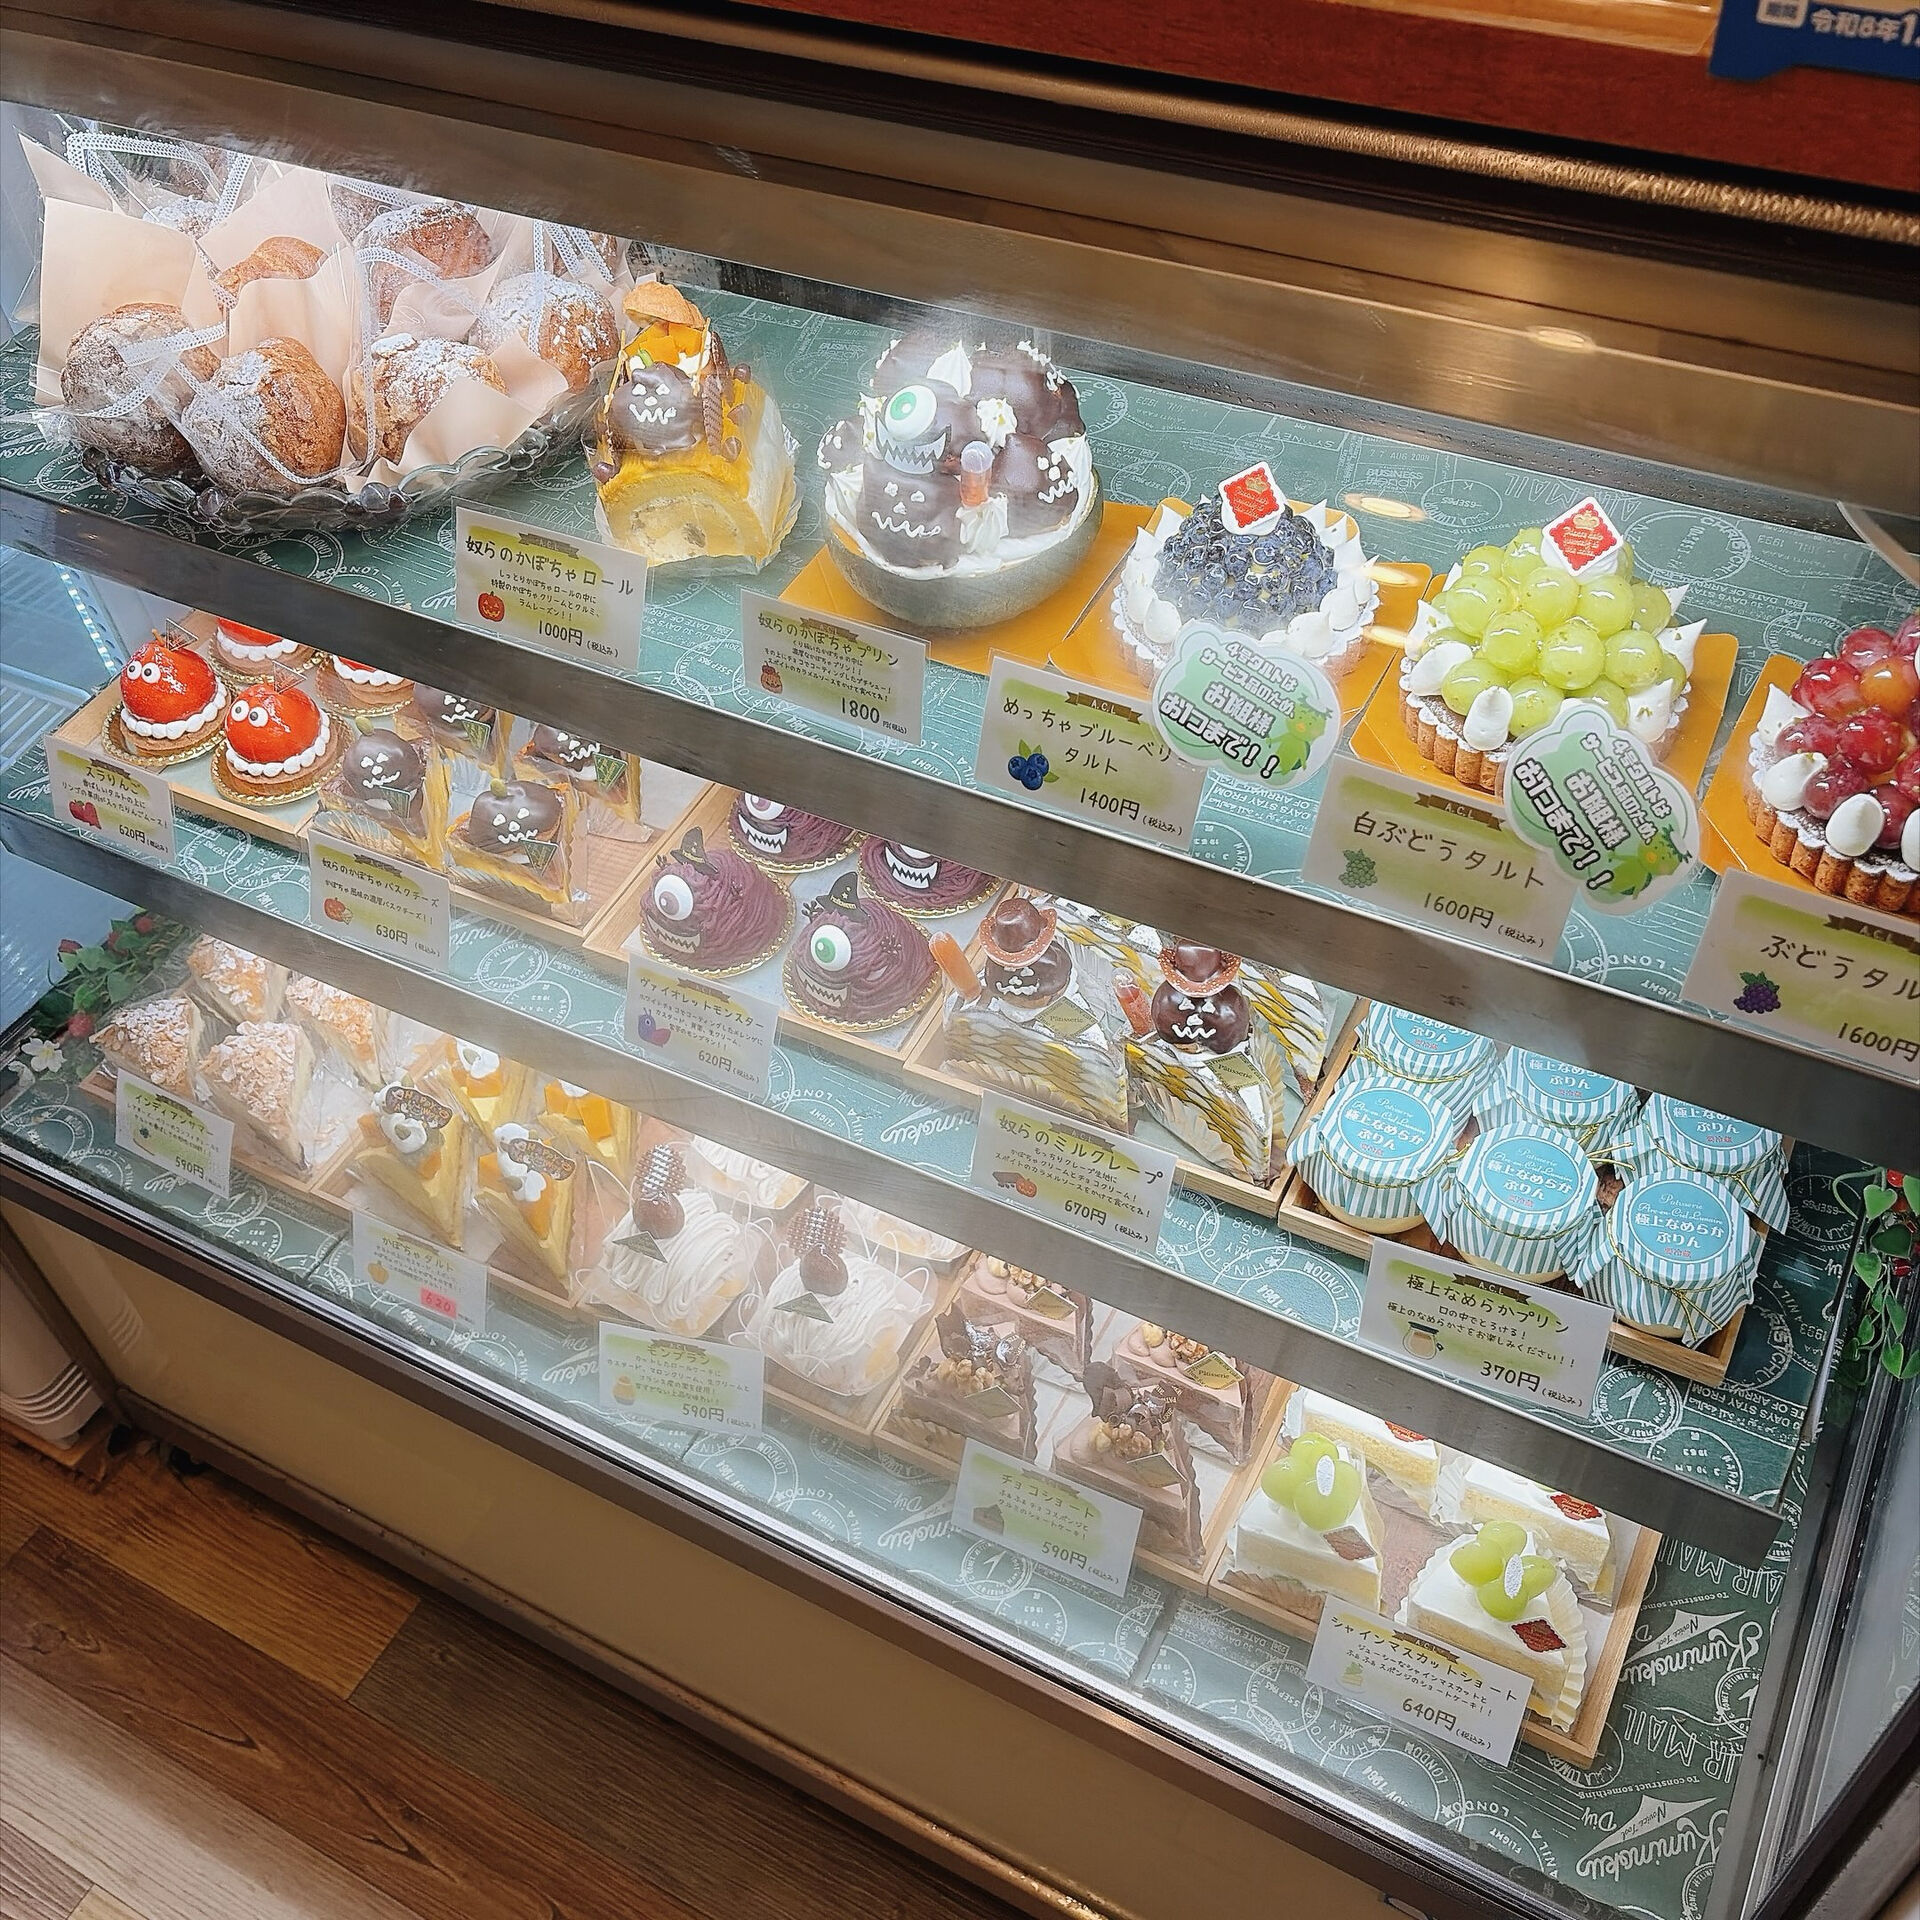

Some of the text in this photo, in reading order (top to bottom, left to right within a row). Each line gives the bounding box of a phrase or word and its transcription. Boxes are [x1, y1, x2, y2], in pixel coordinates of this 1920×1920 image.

[465, 535, 633, 595] 奴らのかぼちゃロール
[499, 569, 597, 604] しっとりかぼちゃロールの中に
[538, 620, 583, 646] 1000円
[758, 612, 899, 666] 奴らのかぼちゃプリン
[842, 697, 880, 724] 1800
[1065, 747, 1118, 775] タルト
[86, 766, 140, 795] スラりんご
[1080, 787, 1140, 820] 1400円
[1213, 786, 1311, 820] DAYS STAY FROM
[119, 825, 146, 843] 620円
[1353, 811, 1543, 888] 白ぶどうタルト
[322, 857, 439, 908] 奴らのかぼちゃバスクチーズ
[1424, 893, 1494, 928] 1600円
[376, 924, 408, 946] 630円
[640, 977, 765, 1029] ヴァイオレットモンスター
[1410, 1025, 1448, 1043] ぷりん
[1838, 1023, 1920, 1063] 1600円
[698, 1050, 732, 1073] 620円
[1550, 1076, 1591, 1089] ぷりん
[1344, 1107, 1425, 1146] 極上なめらか
[1357, 1129, 1397, 1151] ぷりん
[1697, 1121, 1740, 1134] ぷりん
[998, 1114, 1164, 1185] 奴らのミルクレープ
[175, 1156, 204, 1180] 590円
[1486, 1160, 1573, 1194] 極上なめらか
[1504, 1180, 1546, 1201] ぷりん
[1064, 1199, 1107, 1226] 670円
[1635, 1212, 1725, 1238] 極上なめらか
[1657, 1231, 1701, 1249] ぷりん
[426, 1292, 452, 1312] 620
[1406, 1273, 1569, 1334] 極上なめらかプリン
[1438, 1305, 1527, 1340] 口の中でとろける！
[647, 1345, 710, 1365] モンブラン
[1480, 1360, 1541, 1394] 370円
[682, 1403, 725, 1423] 590円
[1728, 1396, 1757, 1415] STAY
[1760, 1409, 1791, 1426] DAYS
[1002, 1473, 1094, 1519] チョコショート
[1041, 1541, 1088, 1570] 590円
[1330, 1616, 1518, 1702] シャインマスカットショート
[1402, 1698, 1457, 1732] 640円
[1622, 1704, 1696, 1767] MAIL
[1577, 1783, 1634, 1800] something
[1635, 1777, 1685, 1792] construct
